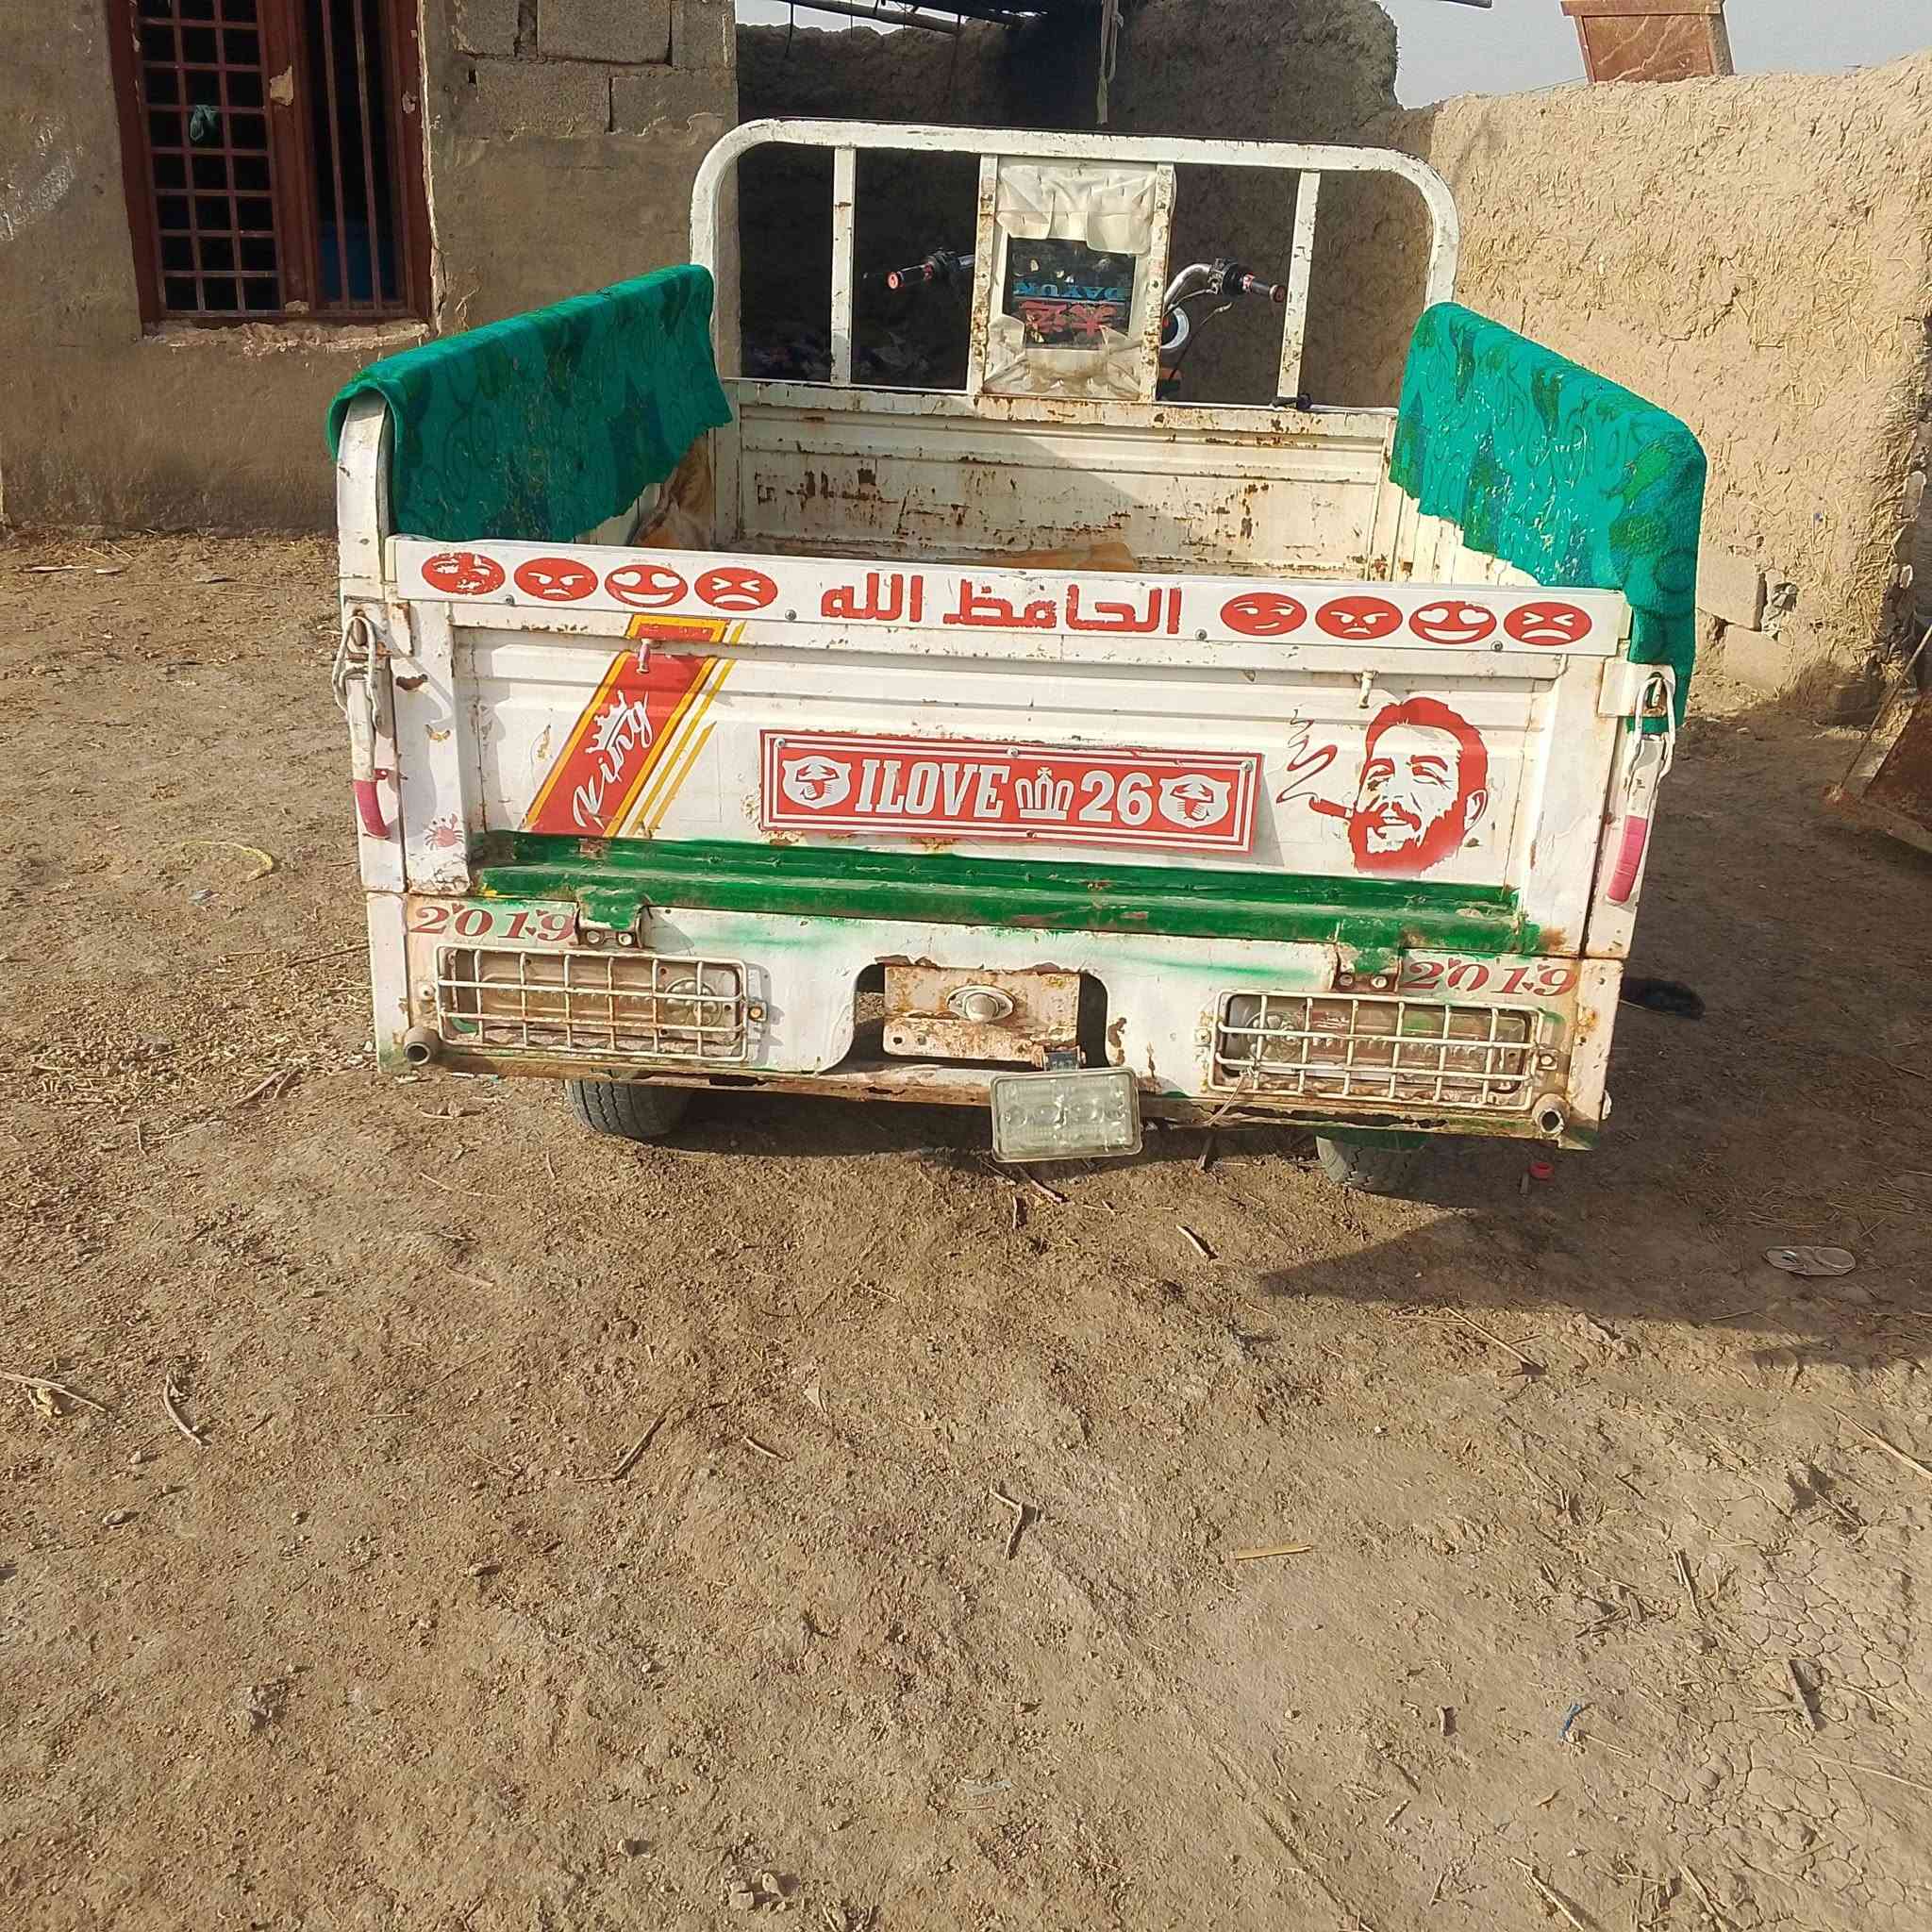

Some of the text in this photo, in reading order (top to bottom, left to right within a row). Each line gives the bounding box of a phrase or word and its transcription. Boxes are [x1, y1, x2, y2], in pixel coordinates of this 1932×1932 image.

[821, 572, 924, 623] الله
[573, 691, 653, 830] King
[1078, 770, 1153, 825] 26
[409, 906, 575, 941] 2019
[1398, 960, 1578, 997] 2019
